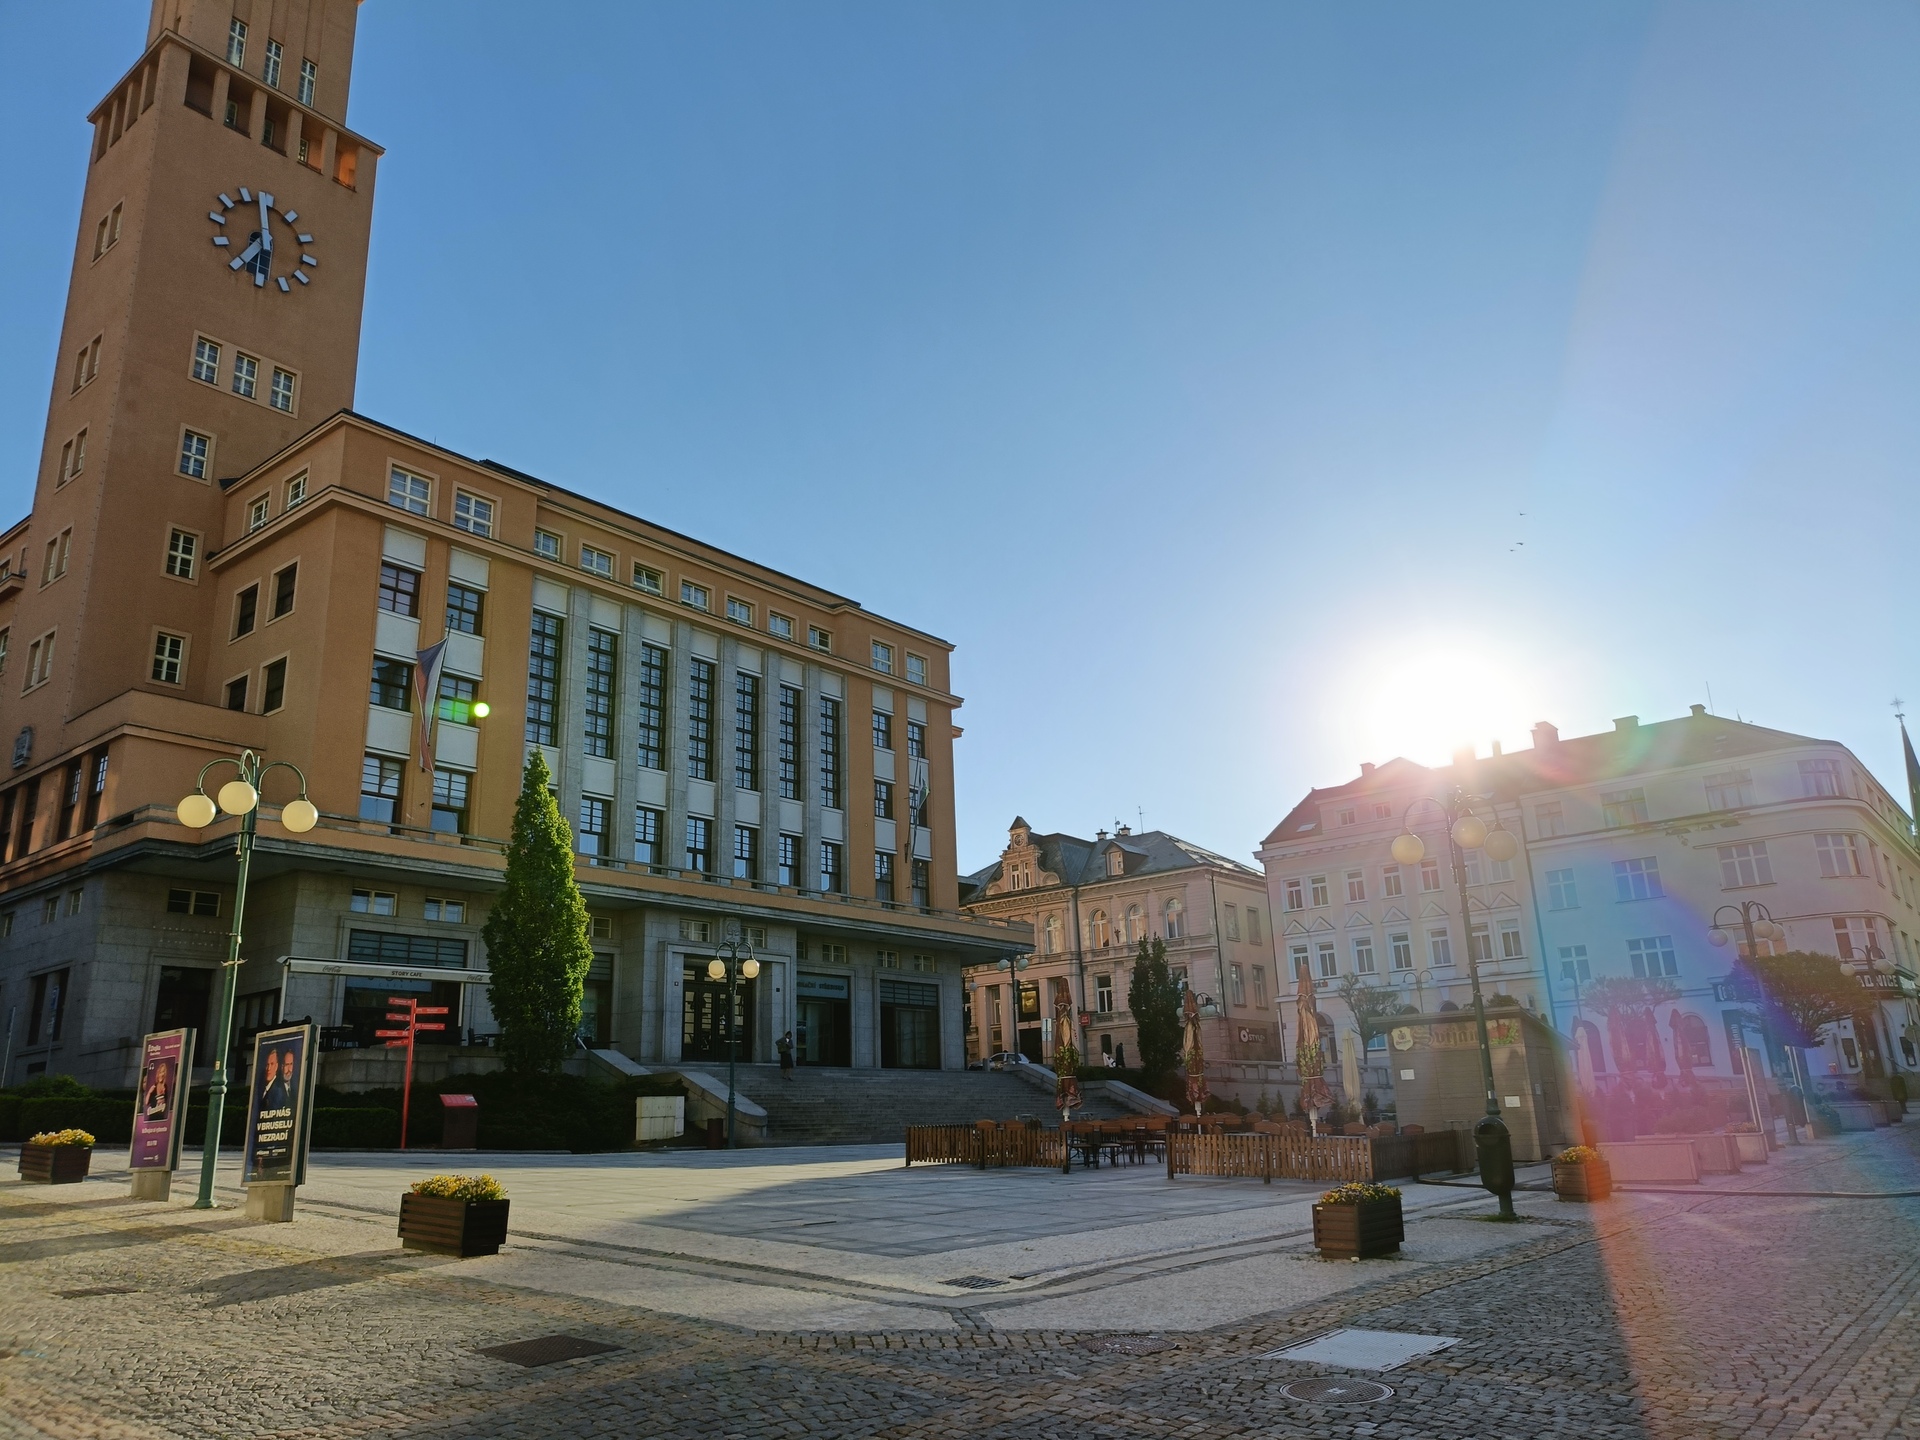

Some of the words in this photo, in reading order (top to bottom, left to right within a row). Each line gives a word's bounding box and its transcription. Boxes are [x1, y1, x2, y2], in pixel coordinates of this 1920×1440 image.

[260, 1109, 276, 1119] FILIP
[276, 1106, 291, 1117] NÁS
[257, 1123, 262, 1131] V
[261, 1120, 293, 1130] BRUSELU
[258, 1130, 288, 1142] NEZRADÍ
